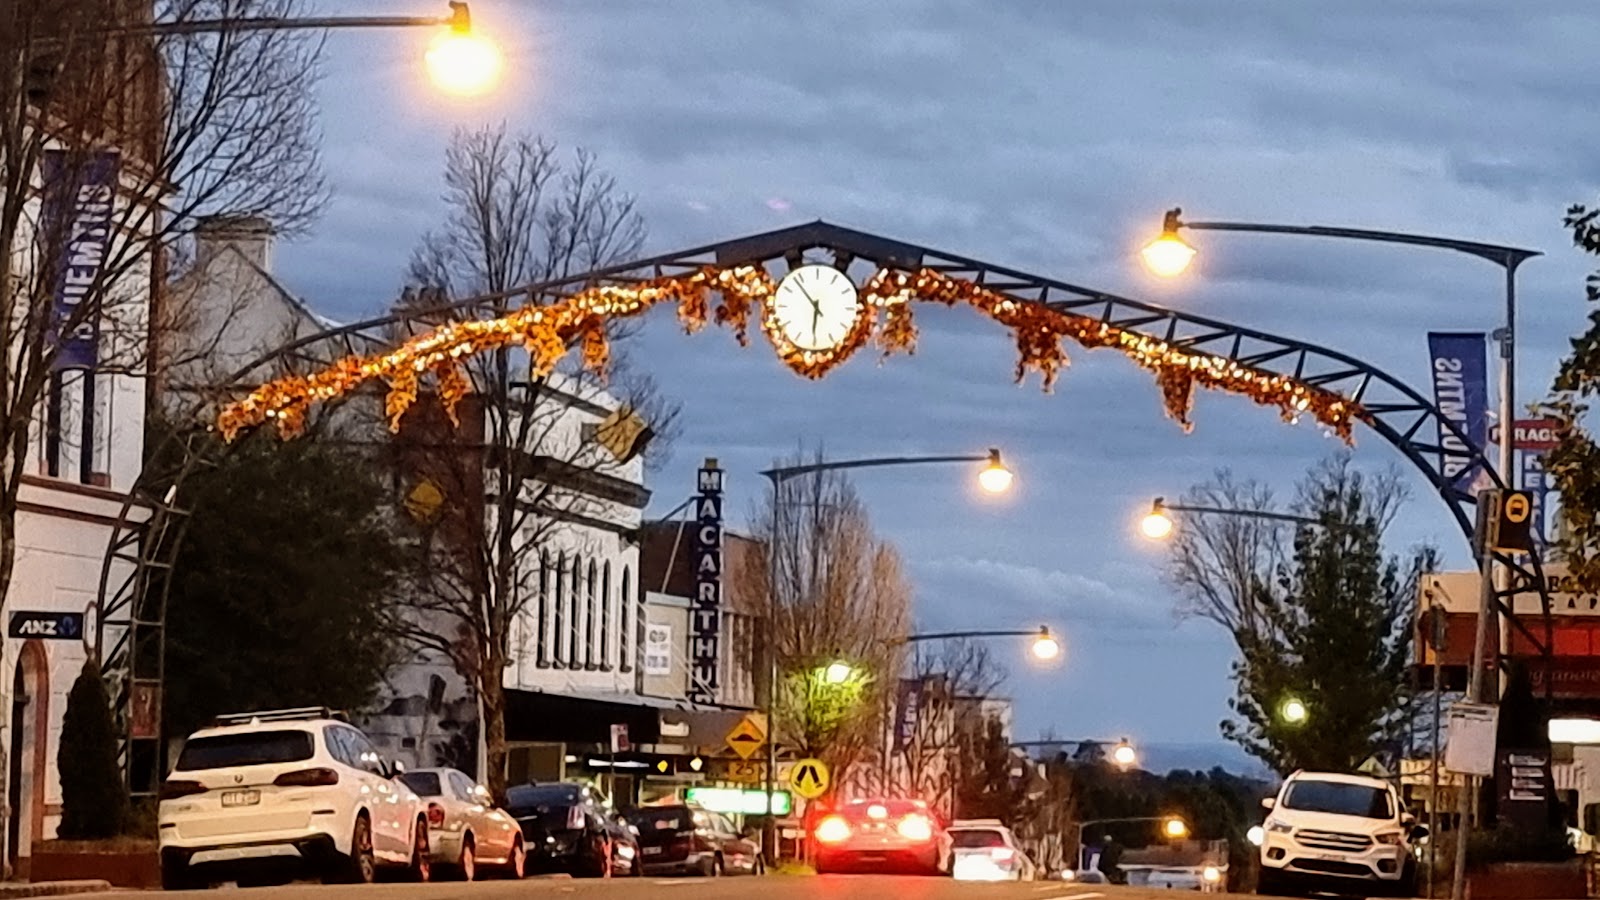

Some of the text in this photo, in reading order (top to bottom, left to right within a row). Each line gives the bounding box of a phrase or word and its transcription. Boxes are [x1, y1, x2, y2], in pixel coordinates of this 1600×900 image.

[58, 184, 112, 340] UEMTNS
[1491, 427, 1561, 441] FRAG
[19, 620, 57, 635] ANZ
